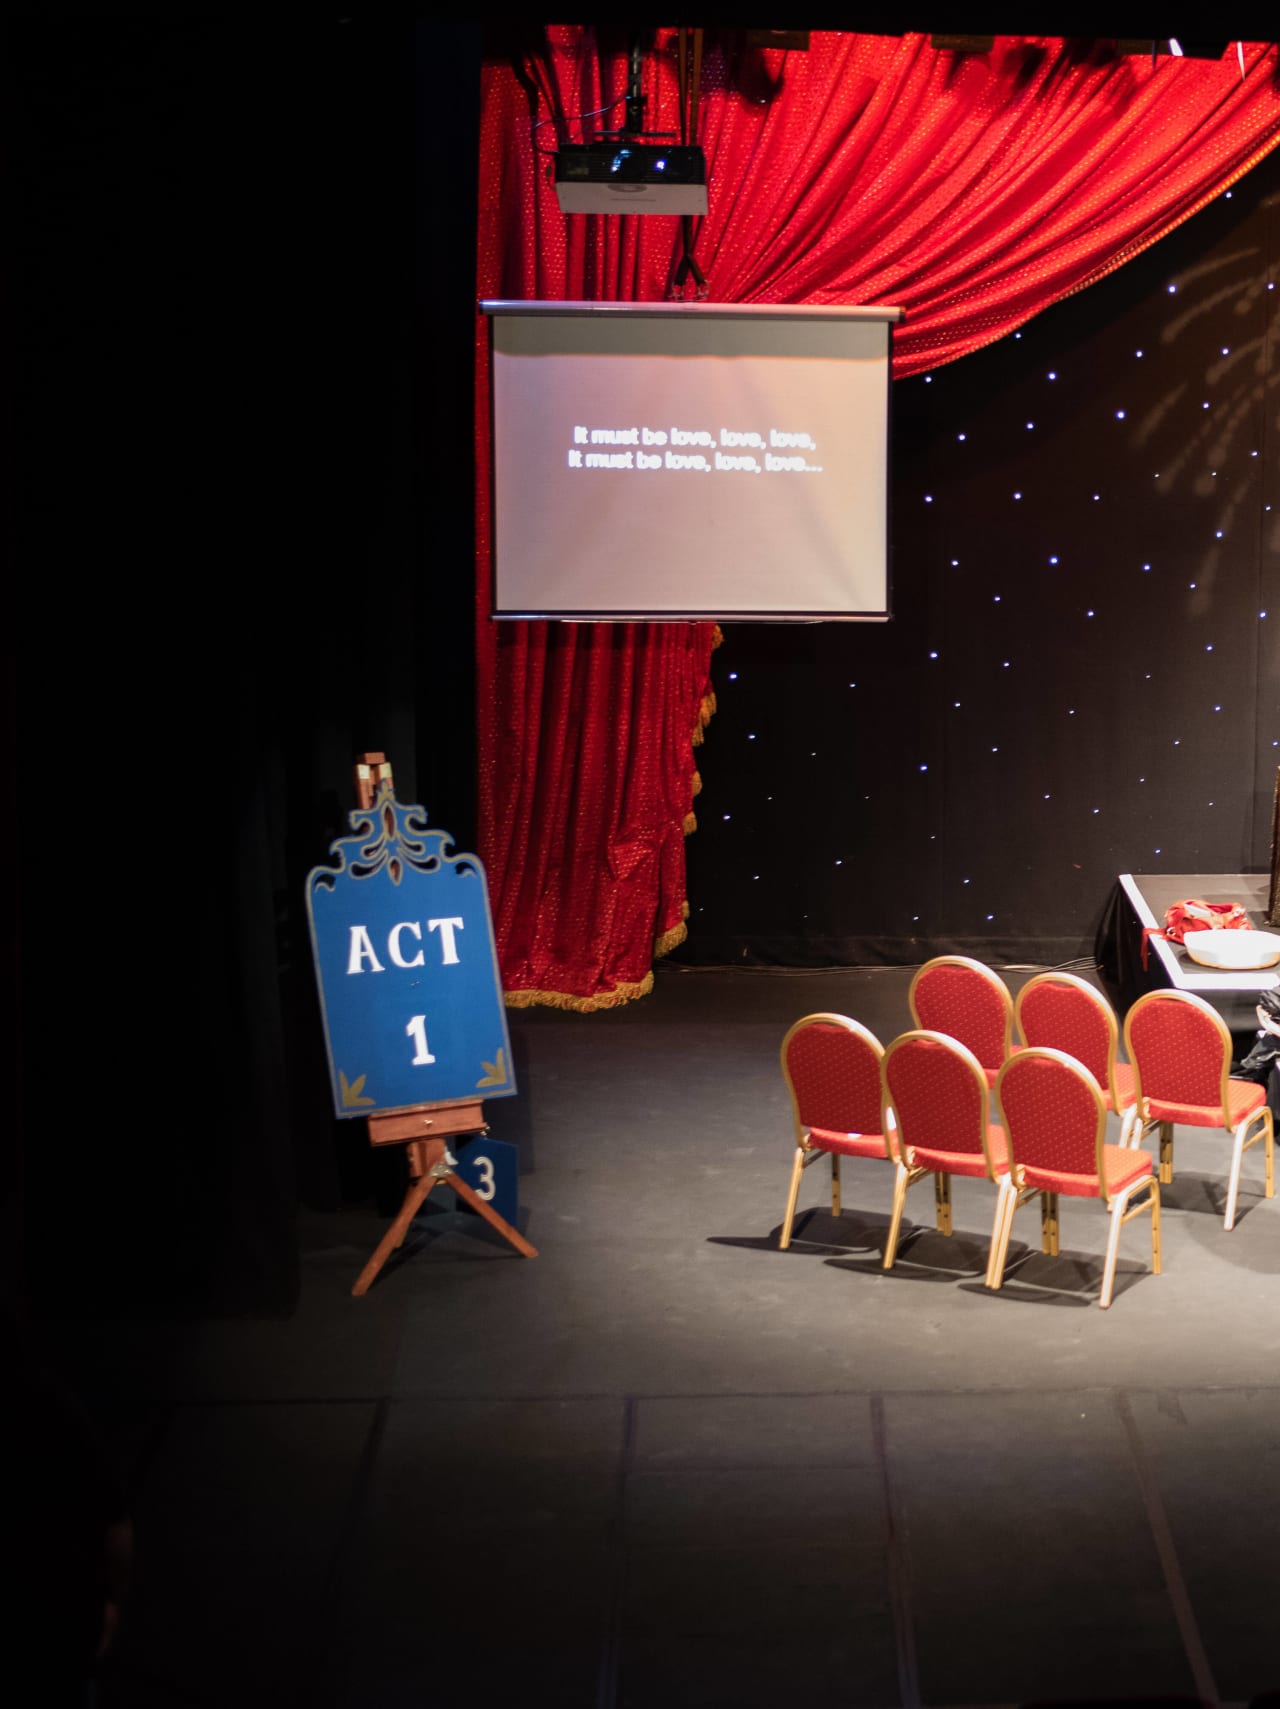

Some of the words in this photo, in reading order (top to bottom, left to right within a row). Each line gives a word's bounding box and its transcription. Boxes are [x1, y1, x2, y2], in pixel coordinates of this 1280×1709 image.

[568, 450, 582, 468] It
[585, 451, 634, 469] must
[636, 451, 662, 469] be
[665, 451, 711, 472] love,
[715, 452, 761, 473] love,
[765, 453, 823, 472] love...
[574, 426, 588, 444] It
[591, 427, 639, 445] must
[642, 427, 667, 445] be
[671, 427, 717, 449] love,
[720, 428, 766, 450] love,
[770, 429, 816, 451] love,
[346, 916, 465, 975] ACT
[405, 1014, 436, 1066] 1
[472, 1155, 496, 1202] 3
